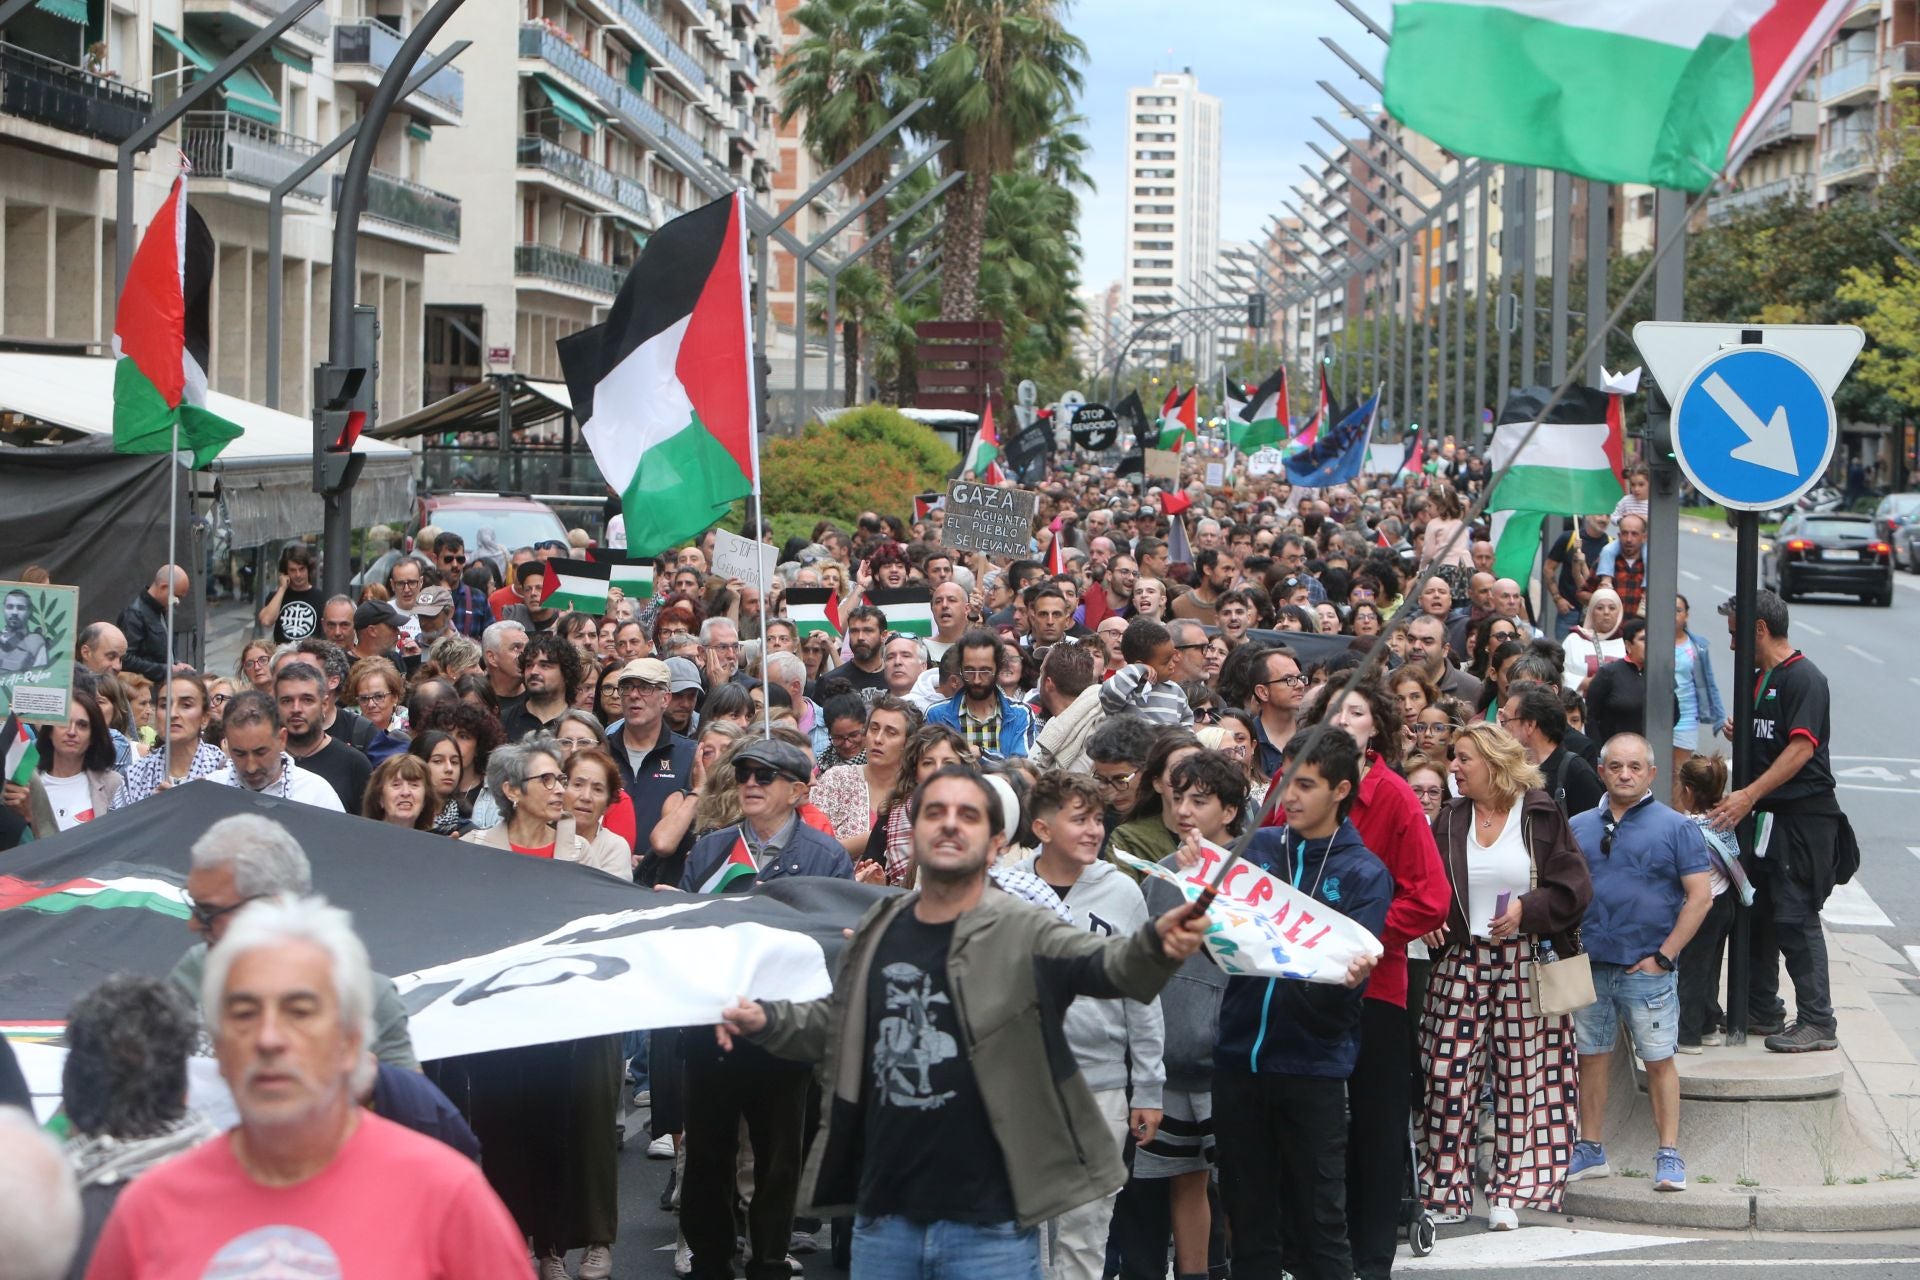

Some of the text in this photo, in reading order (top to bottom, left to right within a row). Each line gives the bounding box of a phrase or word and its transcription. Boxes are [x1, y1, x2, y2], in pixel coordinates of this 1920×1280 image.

[1080, 409, 1105, 420] STOP
[1072, 420, 1117, 432] GENOCIDIO
[952, 484, 1014, 511] GAZA
[947, 517, 1018, 538] EL PUEBLO
[973, 509, 1028, 529] AGUANTA
[729, 539, 759, 557] STOP
[955, 534, 1027, 554] SE LEVANTA
